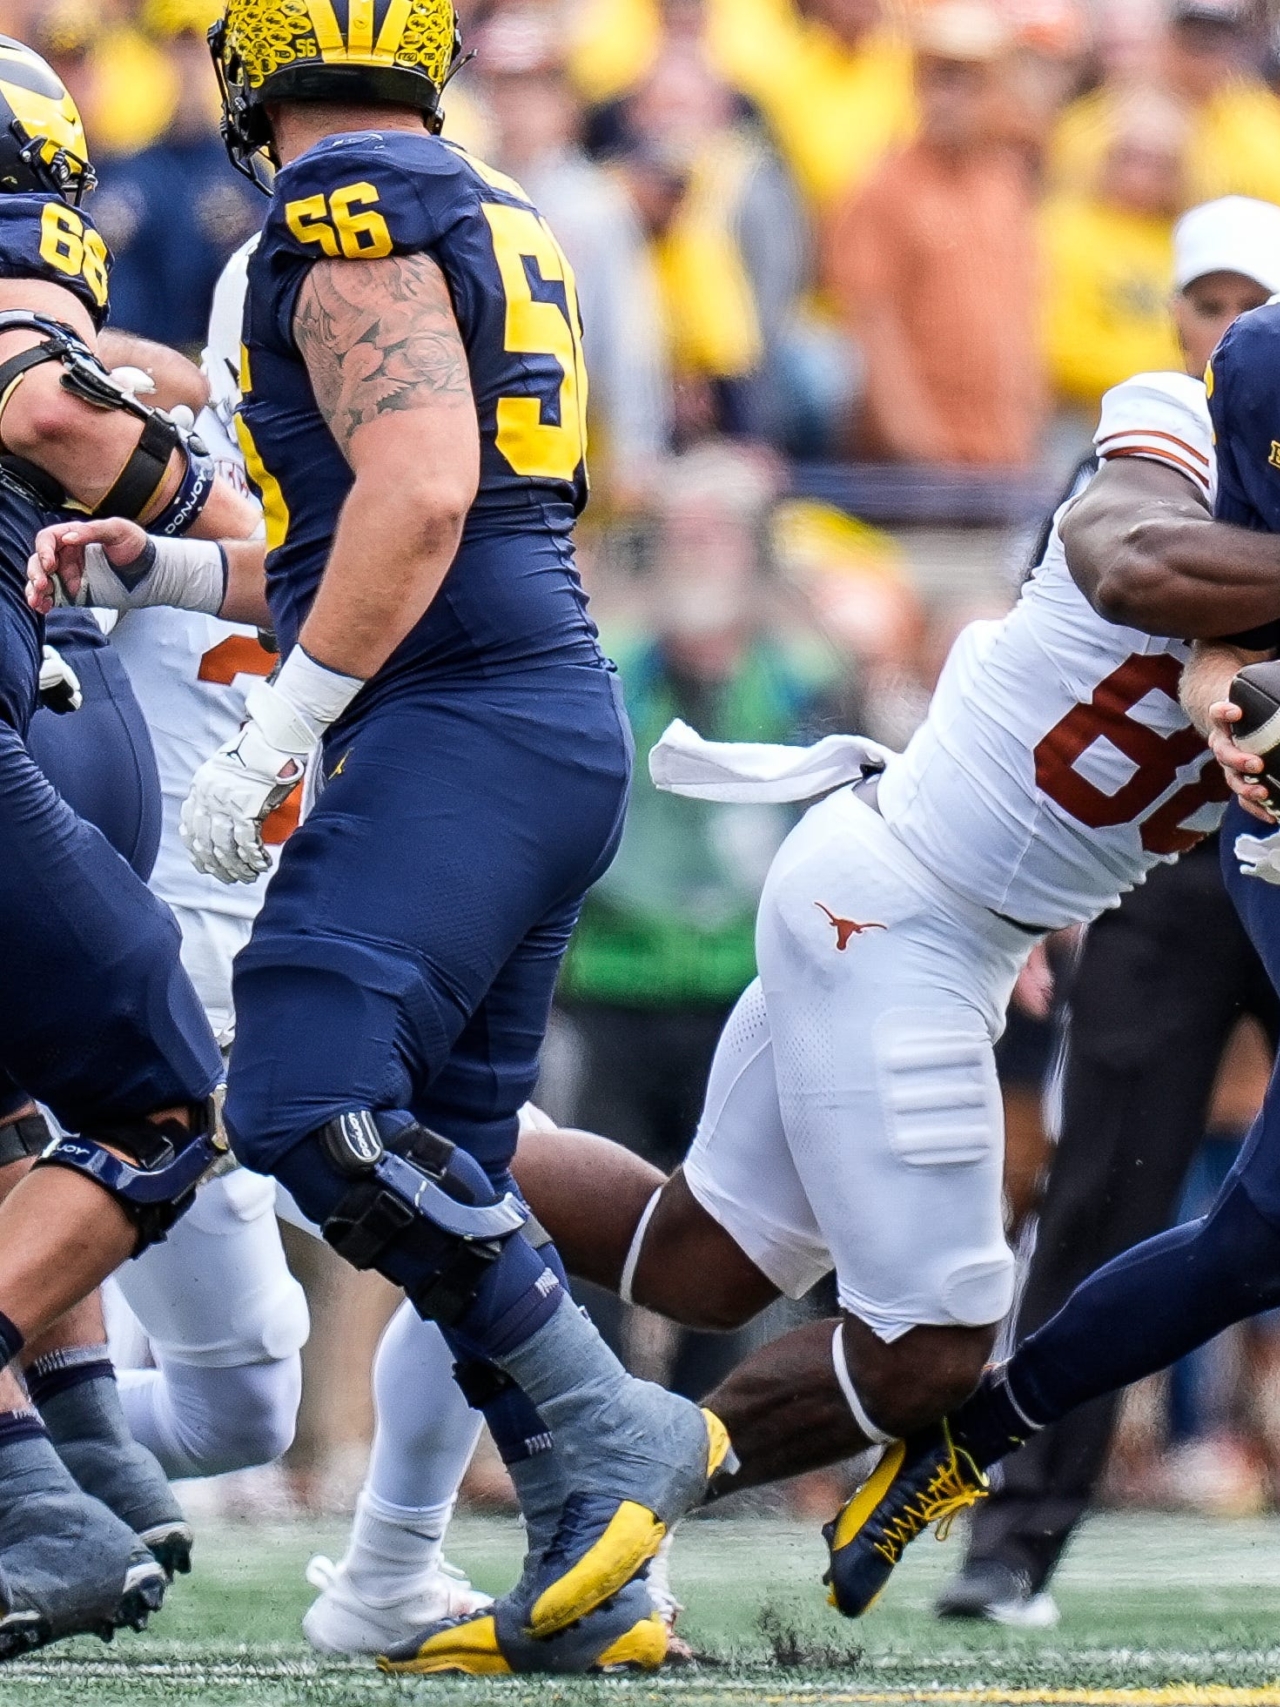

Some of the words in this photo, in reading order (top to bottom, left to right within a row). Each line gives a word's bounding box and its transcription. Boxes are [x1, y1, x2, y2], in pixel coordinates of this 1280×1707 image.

[296, 38, 317, 58] 56
[285, 181, 393, 258] 56
[481, 202, 590, 490] 5
[164, 467, 207, 535] DONJOY
